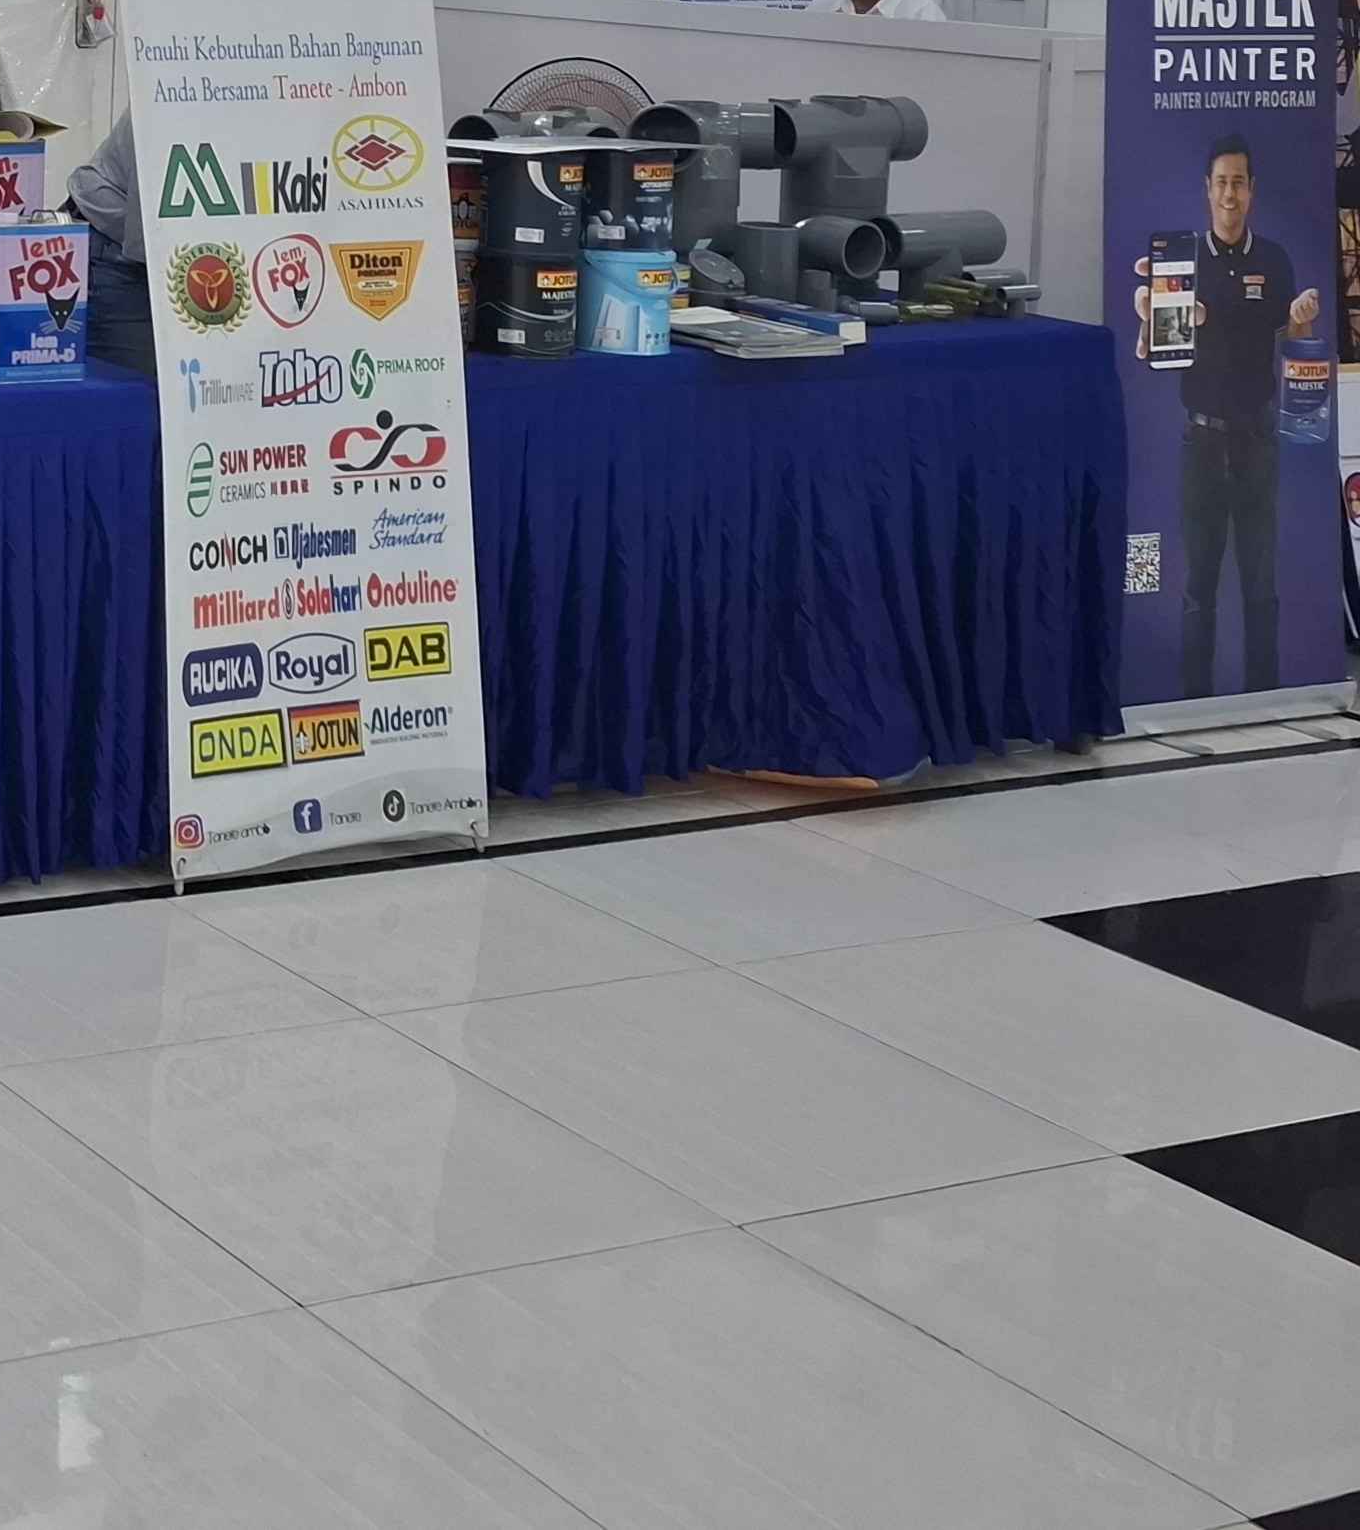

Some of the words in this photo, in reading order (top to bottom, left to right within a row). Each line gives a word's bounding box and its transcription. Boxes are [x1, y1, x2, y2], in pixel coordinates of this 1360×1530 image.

[134, 33, 190, 62] Penuhi
[193, 34, 285, 61] Kebutuhan
[289, 33, 342, 59] Bahan
[345, 32, 423, 65] Bangunan
[1154, 47, 1316, 82] PAINTER
[154, 77, 198, 103] Anda
[201, 76, 269, 101] Bersama
[273, 74, 333, 99] Tanete
[349, 73, 407, 98] Ambon
[1154, 92, 1202, 110] PAINTER
[1205, 91, 1251, 109] LOYALTY
[1255, 90, 1316, 108] PROGRAM
[273, 157, 328, 214] Kalsi
[337, 196, 424, 211] ASAHIMAS
[21, 235, 66, 261] lem
[349, 252, 403, 270] Diton
[8, 250, 81, 301] FOX
[267, 257, 310, 293] FOX
[11, 347, 77, 365] PRIMA-D
[31, 333, 58, 348] lem
[259, 349, 343, 407] Toho
[377, 359, 414, 374] PRIMA
[415, 357, 446, 372] ROOF
[1298, 363, 1328, 377] JOTUN
[1289, 380, 1326, 391] MAJESTIC
[219, 449, 249, 475] SUN
[253, 443, 308, 470] POWER
[219, 480, 266, 503] CERAMICS
[333, 475, 446, 496] SPINDO
[372, 508, 446, 529] American
[189, 533, 268, 572] CONCH
[292, 523, 357, 570] Djabesmen
[368, 525, 448, 550] Standard
[366, 571, 457, 609] Onduline
[194, 587, 281, 629] Milliard
[275, 644, 350, 687] Royal
[367, 632, 447, 672] DAB
[190, 656, 257, 696] RUCIKA
[311, 717, 360, 752] JOTUN
[369, 704, 449, 735] Alderon
[198, 723, 278, 763] ONDA
